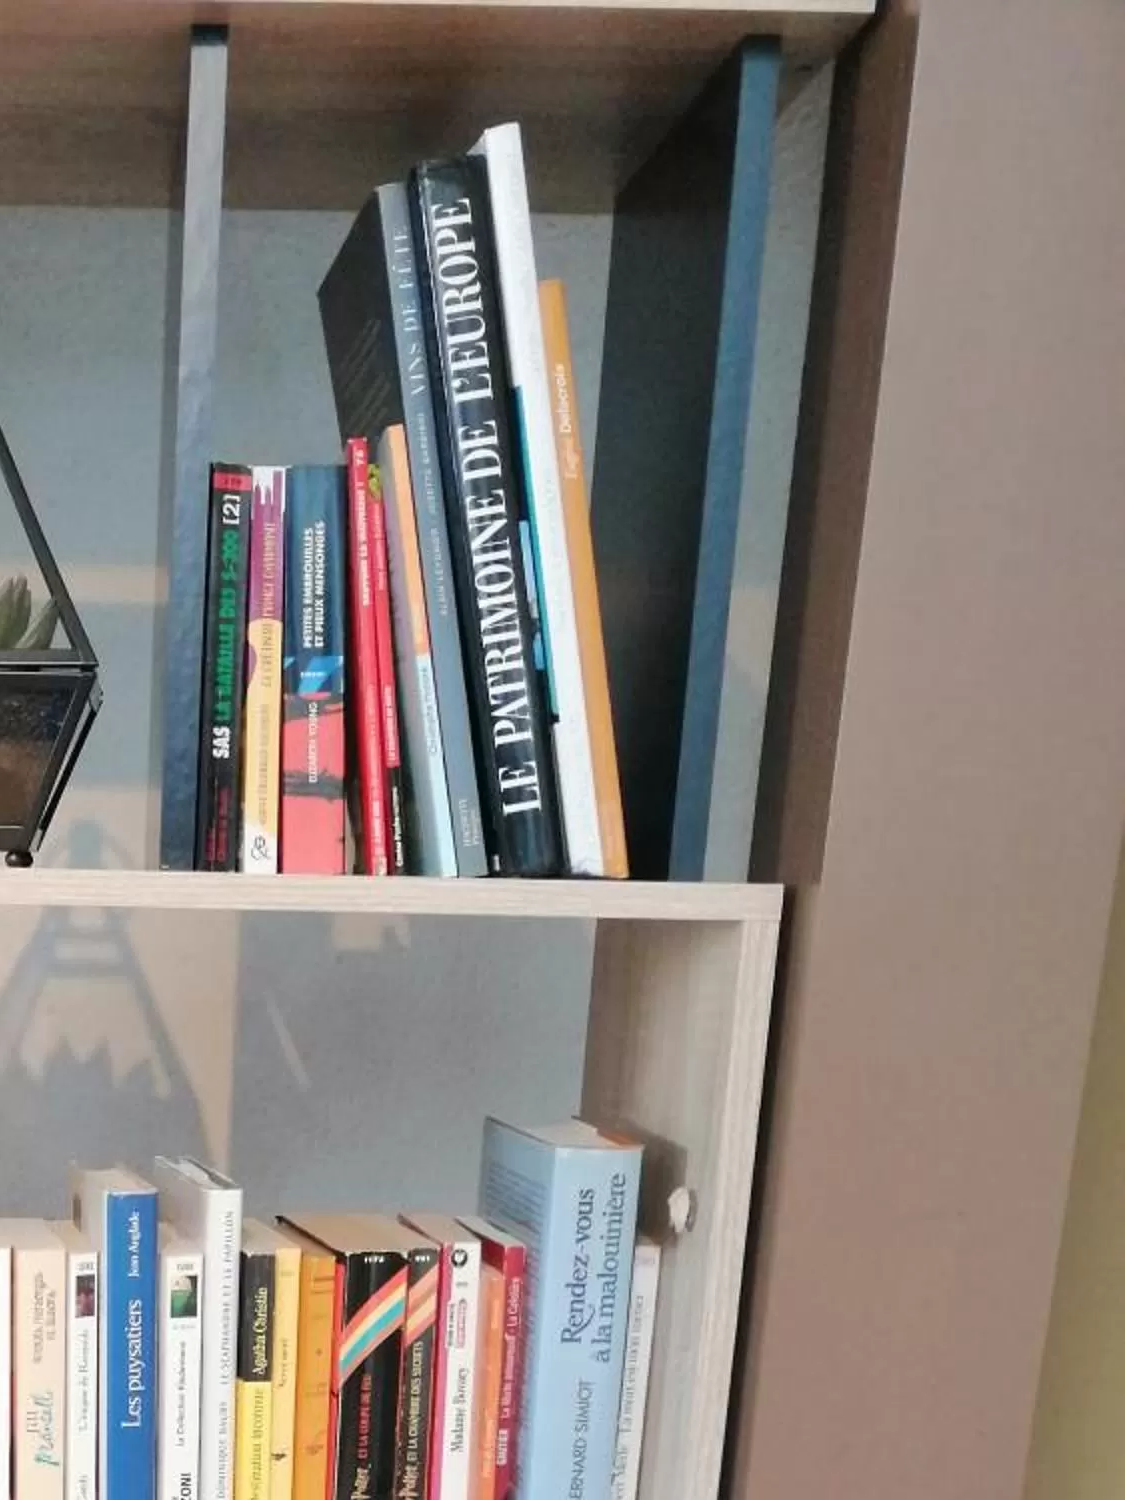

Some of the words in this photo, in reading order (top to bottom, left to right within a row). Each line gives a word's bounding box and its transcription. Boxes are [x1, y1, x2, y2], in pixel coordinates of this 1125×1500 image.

[401, 301, 420, 333] DE
[430, 197, 495, 402] L'EUROPE
[407, 342, 426, 396] VINS
[457, 418, 504, 482] DE
[303, 527, 315, 605] EMBROUILLES
[315, 520, 325, 597] MENSONGES
[302, 607, 314, 648] PETITES
[315, 599, 325, 634] PIEUX
[465, 490, 534, 745] PATRIMOINE
[315, 635, 324, 648] ET
[216, 701, 233, 722] LA
[307, 702, 318, 736] YOUNG
[212, 726, 231, 759] SAS
[497, 761, 543, 817] LE
[560, 1187, 596, 1345] Rendez-vous
[595, 1172, 627, 1319] malouinière
[122, 1298, 146, 1392] puysatiers
[251, 1334, 268, 1375] Agatha
[591, 1324, 614, 1345] la
[588, 1350, 611, 1364] à
[120, 1396, 143, 1429] Les
